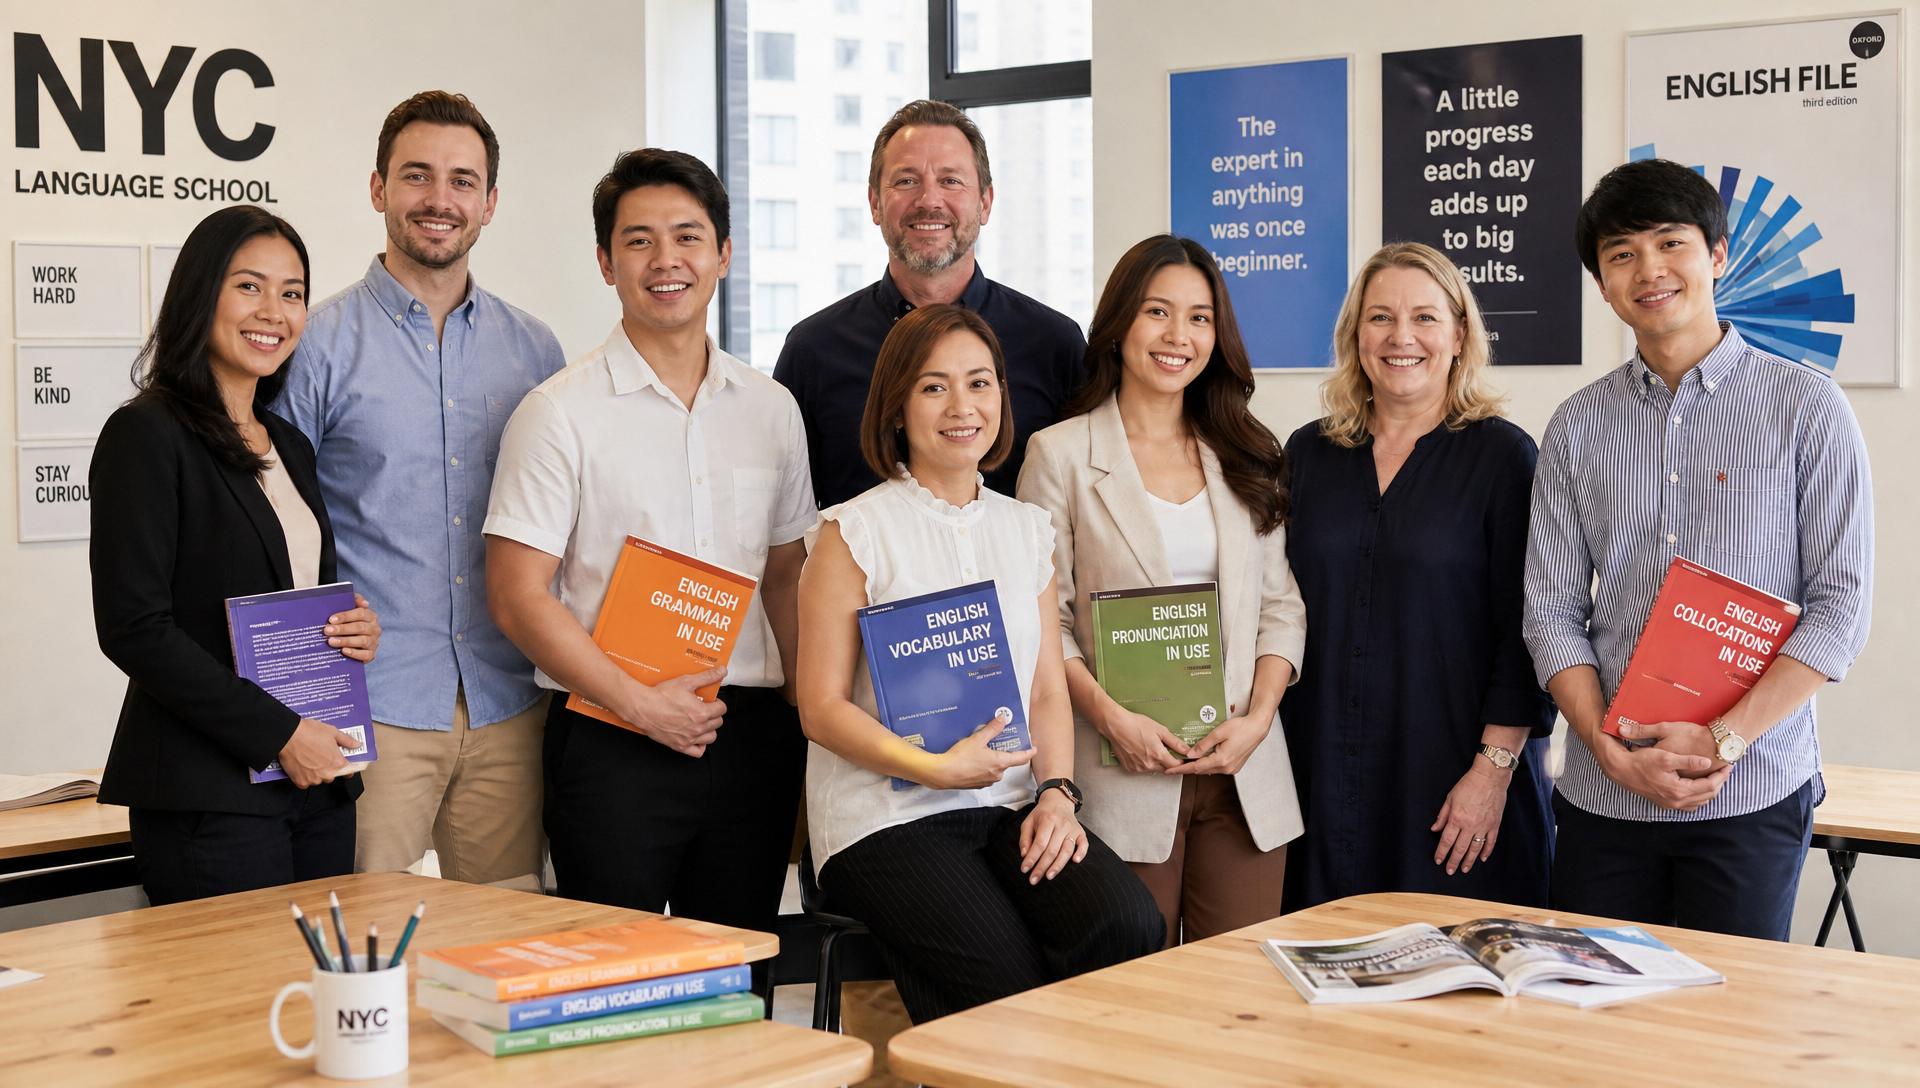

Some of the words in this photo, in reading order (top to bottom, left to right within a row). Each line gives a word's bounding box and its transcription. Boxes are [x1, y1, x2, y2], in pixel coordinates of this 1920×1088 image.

[1852, 35, 1882, 44] OXFORD
[1666, 67, 1790, 101] ENGLISH
[1798, 62, 1858, 92] FILE
[14, 32, 276, 162] NYC
[1435, 89, 1454, 113] A
[1461, 84, 1519, 111] little
[1802, 96, 1824, 108] third
[1826, 95, 1858, 107] edition
[1237, 115, 1276, 137] The
[1425, 123, 1533, 153] progress
[1211, 149, 1279, 177] expert
[1284, 146, 1303, 168] in
[1423, 156, 1481, 182] each
[1488, 154, 1535, 182] day
[15, 169, 164, 199] LANGUAGE
[174, 176, 278, 203] SCHOOL
[1211, 181, 1304, 210] anything
[1429, 191, 1489, 216] adds
[1496, 193, 1528, 217] up
[1210, 222, 1250, 240] was
[1255, 219, 1306, 238] once
[1442, 228, 1468, 250] to
[1476, 224, 1514, 253] big
[32, 266, 78, 284] WORK
[1460, 259, 1525, 283] sults.
[33, 287, 76, 305] HARD
[34, 367, 53, 384] BE
[34, 387, 71, 405] KIND
[35, 465, 71, 483] STAY
[35, 484, 91, 503] CURIOU
[678, 577, 739, 611] ENGLISH
[651, 591, 731, 631] GRAMMAR
[926, 601, 990, 630] ENGLISH
[1152, 602, 1208, 621] ENGLISH
[1724, 601, 1782, 636] ENGLISH
[676, 622, 695, 641] IN
[695, 629, 725, 652] USE
[888, 622, 992, 659] VOCABULARY
[1111, 623, 1209, 645] PRONUNCIATION
[1673, 603, 1773, 655] COLLOCATIONS
[947, 650, 965, 669] IN
[967, 643, 999, 664] USE
[1166, 645, 1180, 661] IN
[1183, 643, 1211, 659] USE
[1718, 645, 1737, 664] IN
[1737, 653, 1765, 675] USE
[562, 995, 607, 1016] ENGLISH
[685, 977, 706, 994] USE
[338, 1008, 388, 1029] NYC
